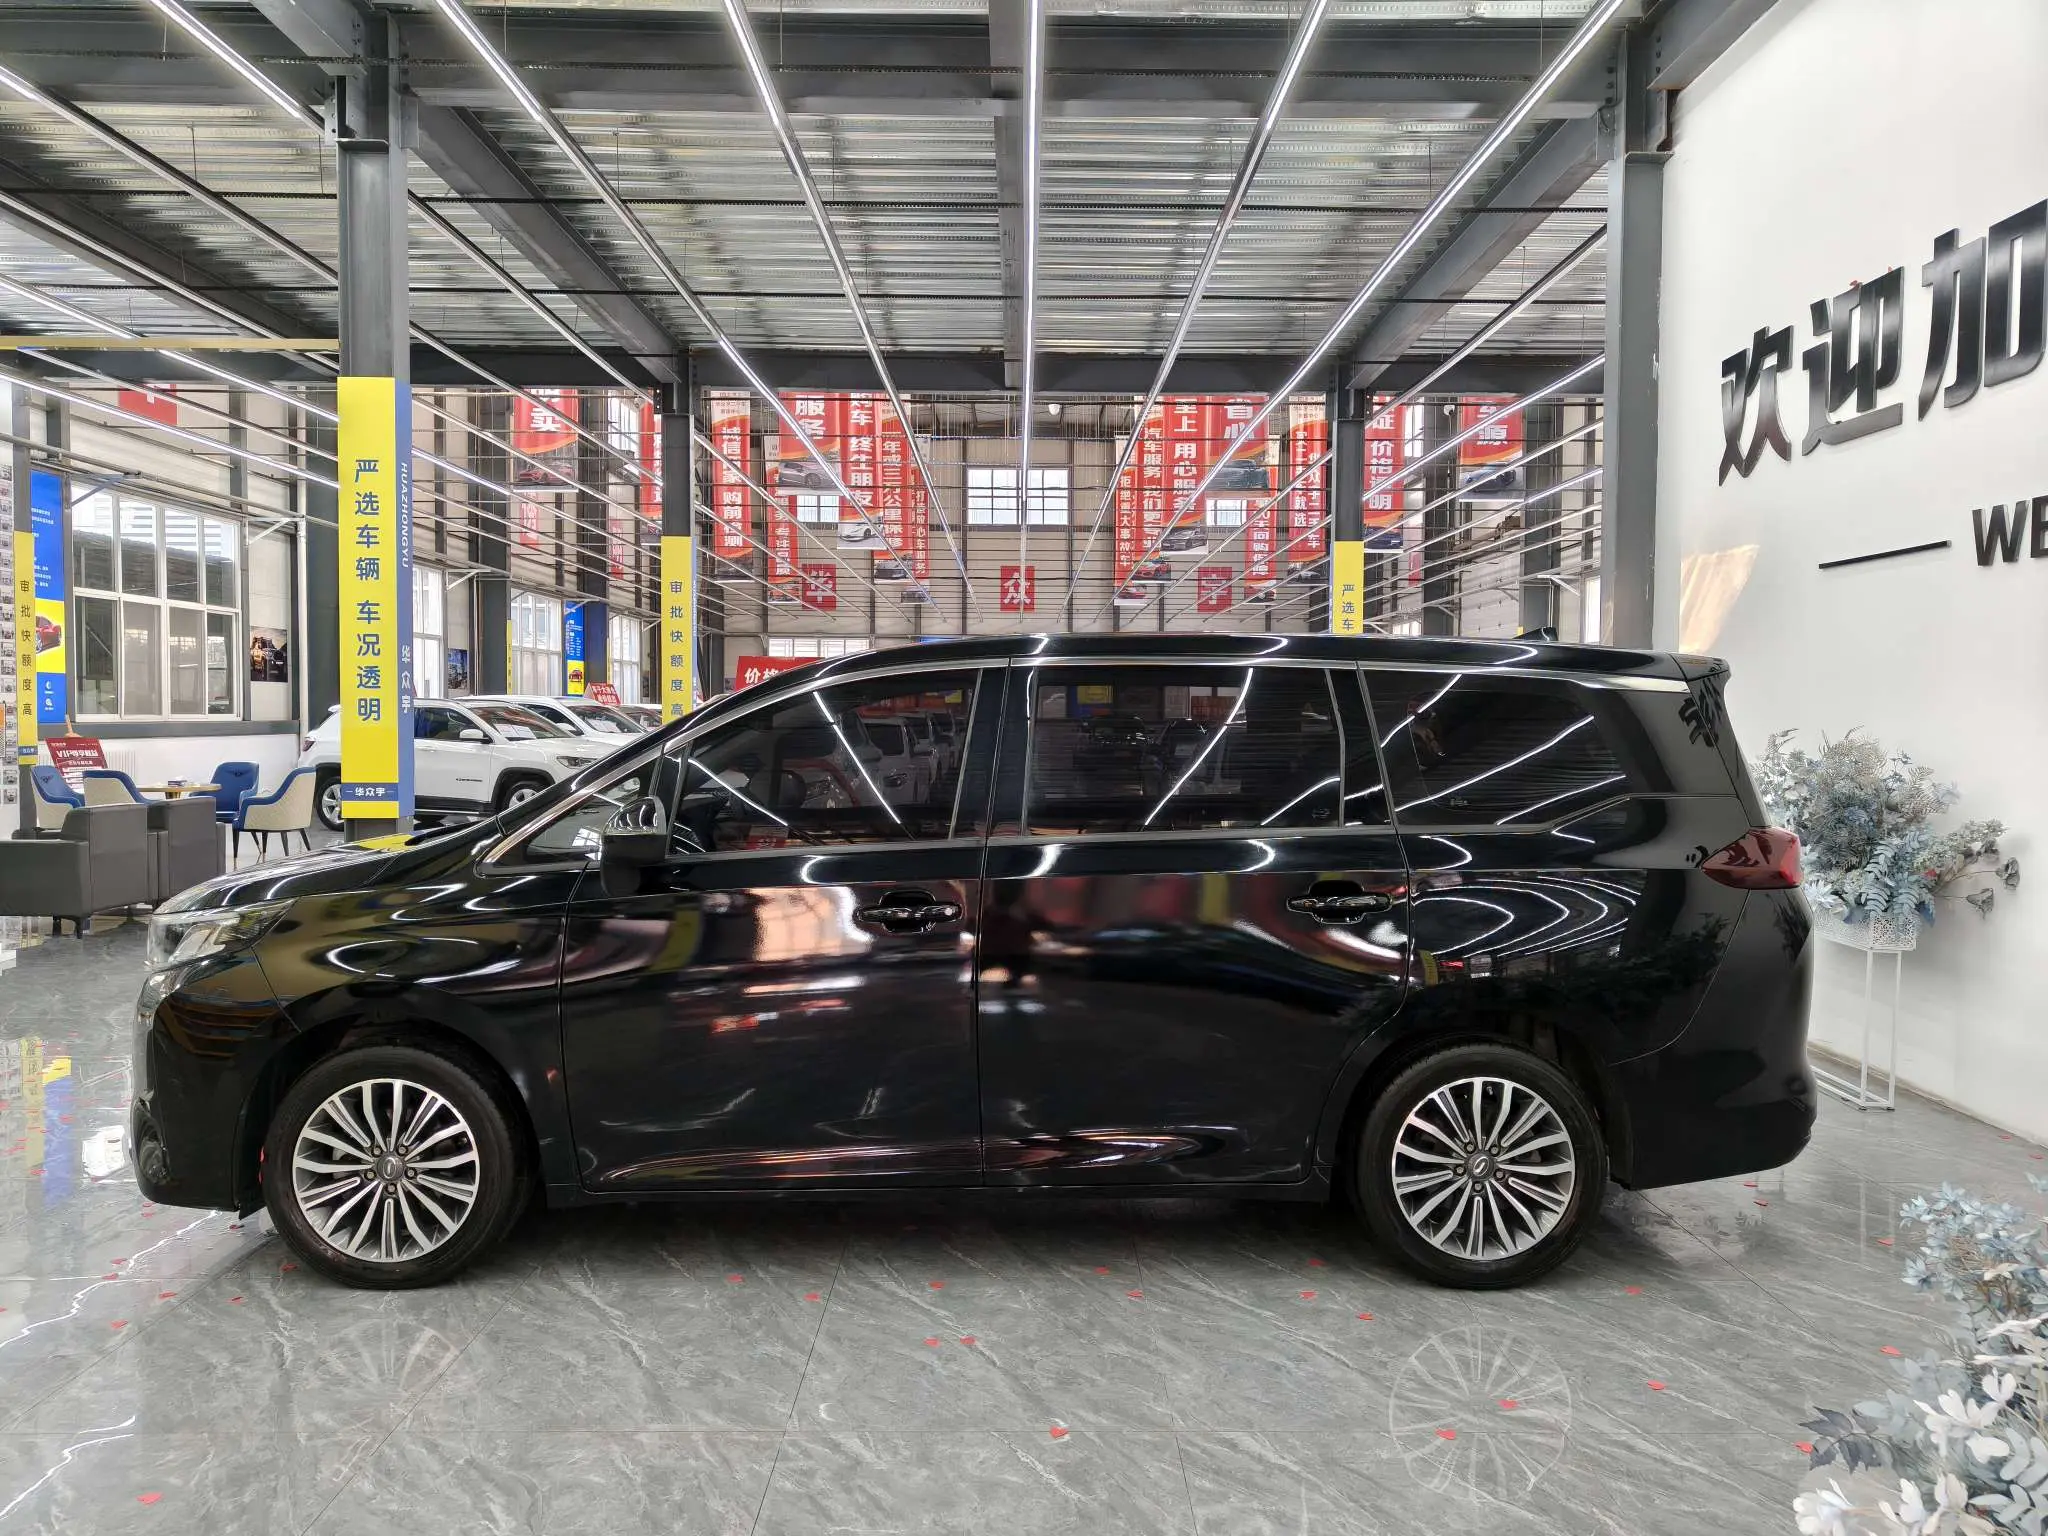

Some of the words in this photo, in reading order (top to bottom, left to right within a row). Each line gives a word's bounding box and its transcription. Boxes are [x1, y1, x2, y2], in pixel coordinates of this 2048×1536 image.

[1719, 199, 2048, 487] 欢迎加
[795, 394, 825, 440] 服务
[850, 393, 874, 426] 购车
[1173, 398, 1198, 432] 至上
[1223, 398, 1255, 442] 省心
[850, 436, 874, 507] 终生朋友
[1143, 427, 1163, 479] 汽车服务
[1173, 442, 1198, 514] 用心服务
[354, 459, 380, 580] 严选车辆
[400, 461, 409, 568] HUAZHONGYU
[1003, 571, 1031, 604] 众
[1200, 573, 1229, 604] 宇
[1341, 584, 1355, 631] 严选车
[356, 600, 381, 721] 车况透明
[670, 580, 684, 717] 审批快额度高
[401, 645, 411, 713] 华众宇
[355, 786, 386, 797] 华众宇
